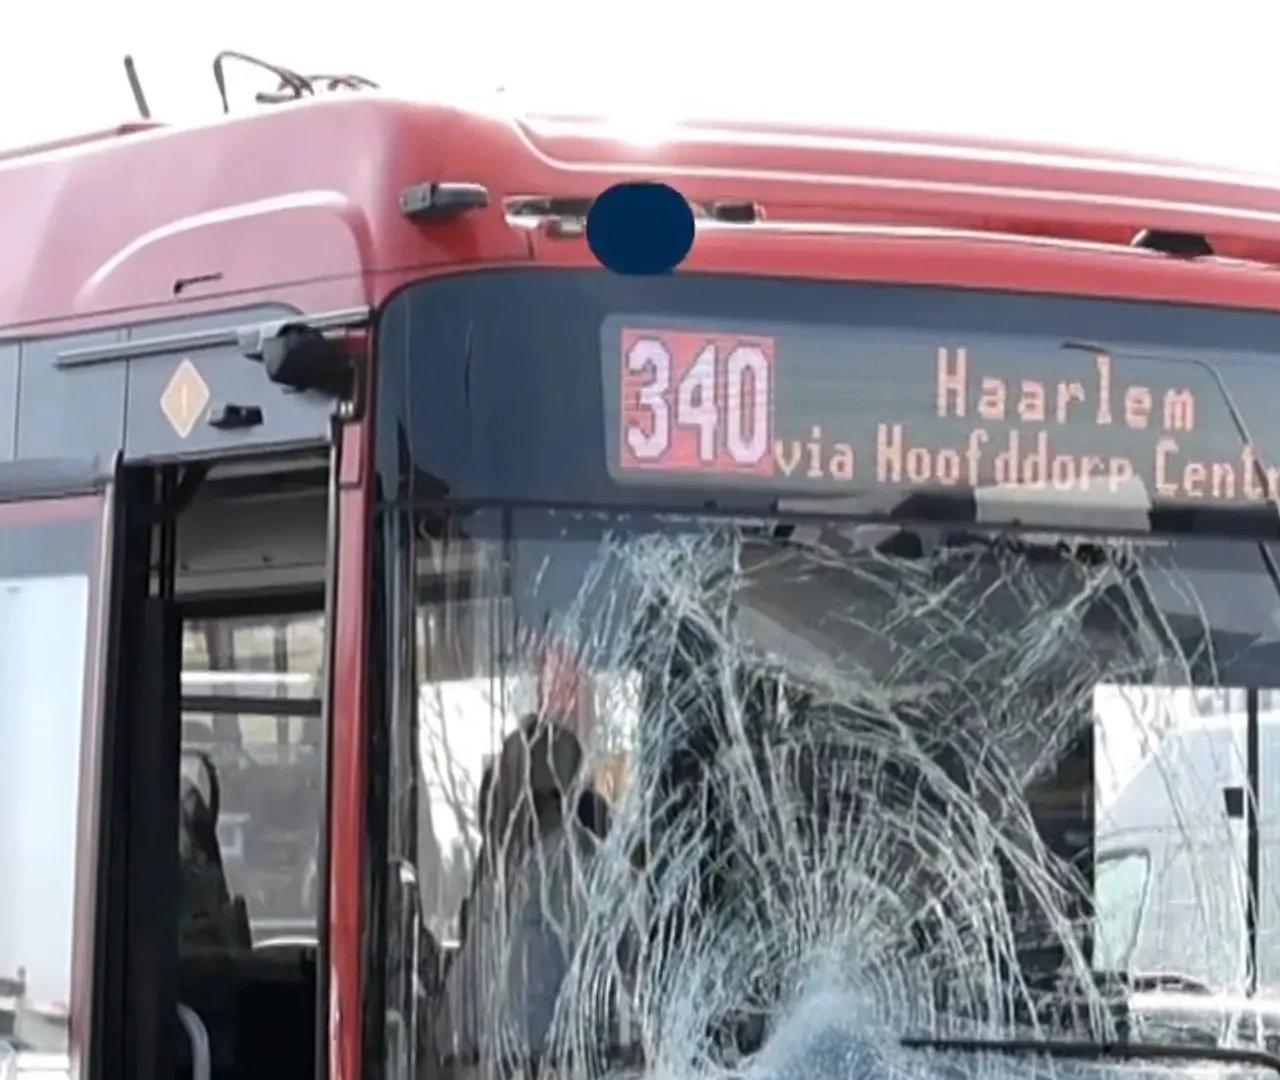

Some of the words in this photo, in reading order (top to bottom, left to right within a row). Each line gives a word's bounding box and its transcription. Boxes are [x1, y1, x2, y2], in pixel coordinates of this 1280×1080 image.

[627, 338, 770, 463] 340
[935, 347, 1195, 431] Haarlem
[774, 425, 854, 481] via
[876, 423, 1133, 494] Hoofddorp
